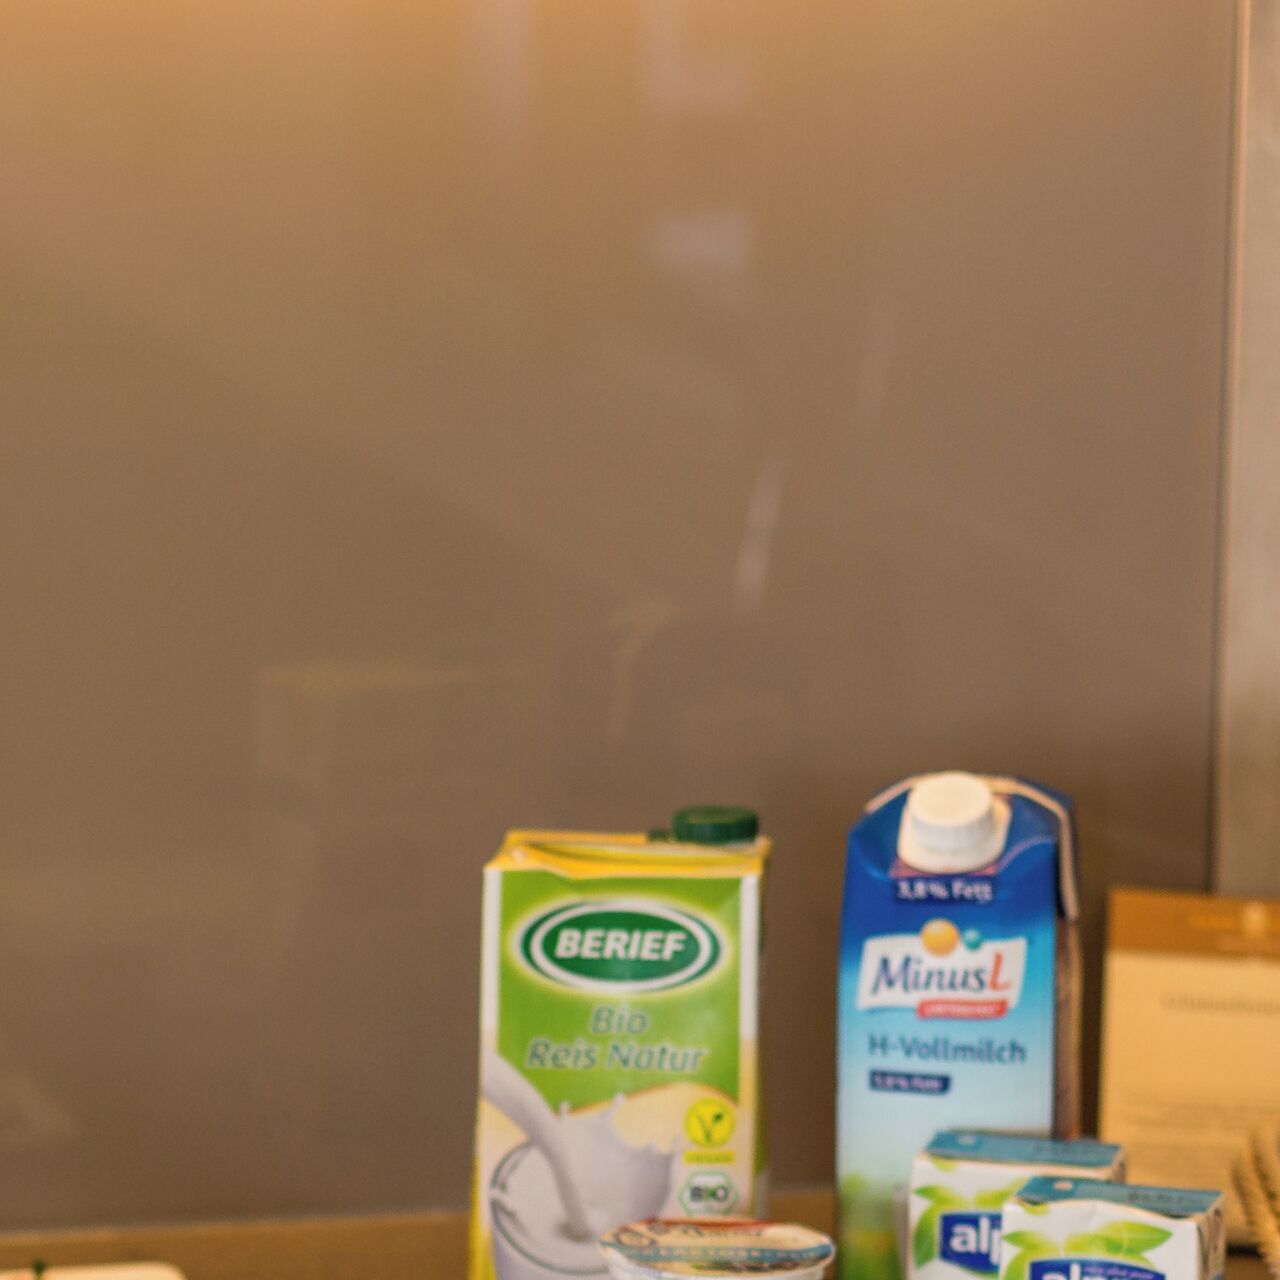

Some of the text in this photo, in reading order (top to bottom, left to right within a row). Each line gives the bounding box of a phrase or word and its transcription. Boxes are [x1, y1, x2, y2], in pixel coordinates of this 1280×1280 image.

[555, 928, 687, 962] BERIEF
[872, 952, 1011, 995] MinusL
[591, 1004, 649, 1034] Bio
[525, 1038, 709, 1073] Reis Natur
[869, 1032, 1028, 1063] H-Vollmilch
